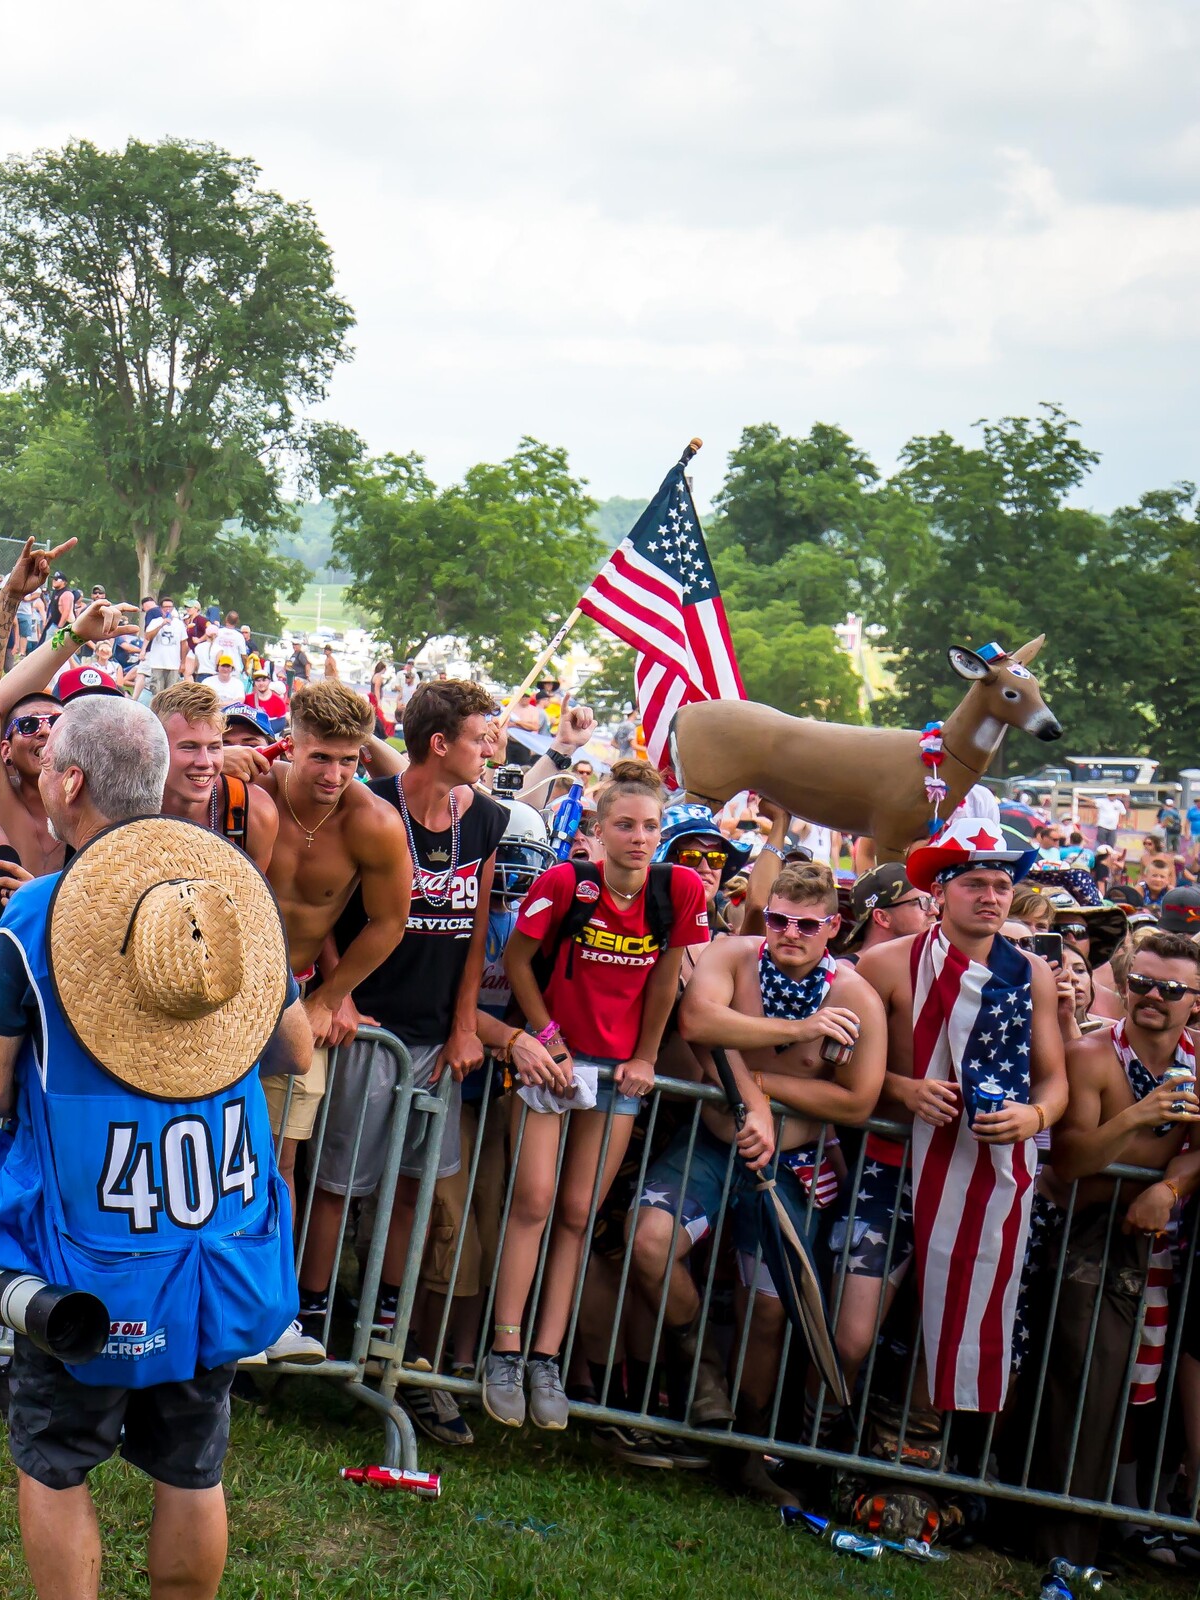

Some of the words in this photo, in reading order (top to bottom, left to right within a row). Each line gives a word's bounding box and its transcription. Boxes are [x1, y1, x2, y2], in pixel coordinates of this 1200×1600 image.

[451, 876, 478, 909] 29
[580, 950, 656, 966] HONDA
[98, 1097, 258, 1233] 404
[122, 1322, 145, 1336] OIL
